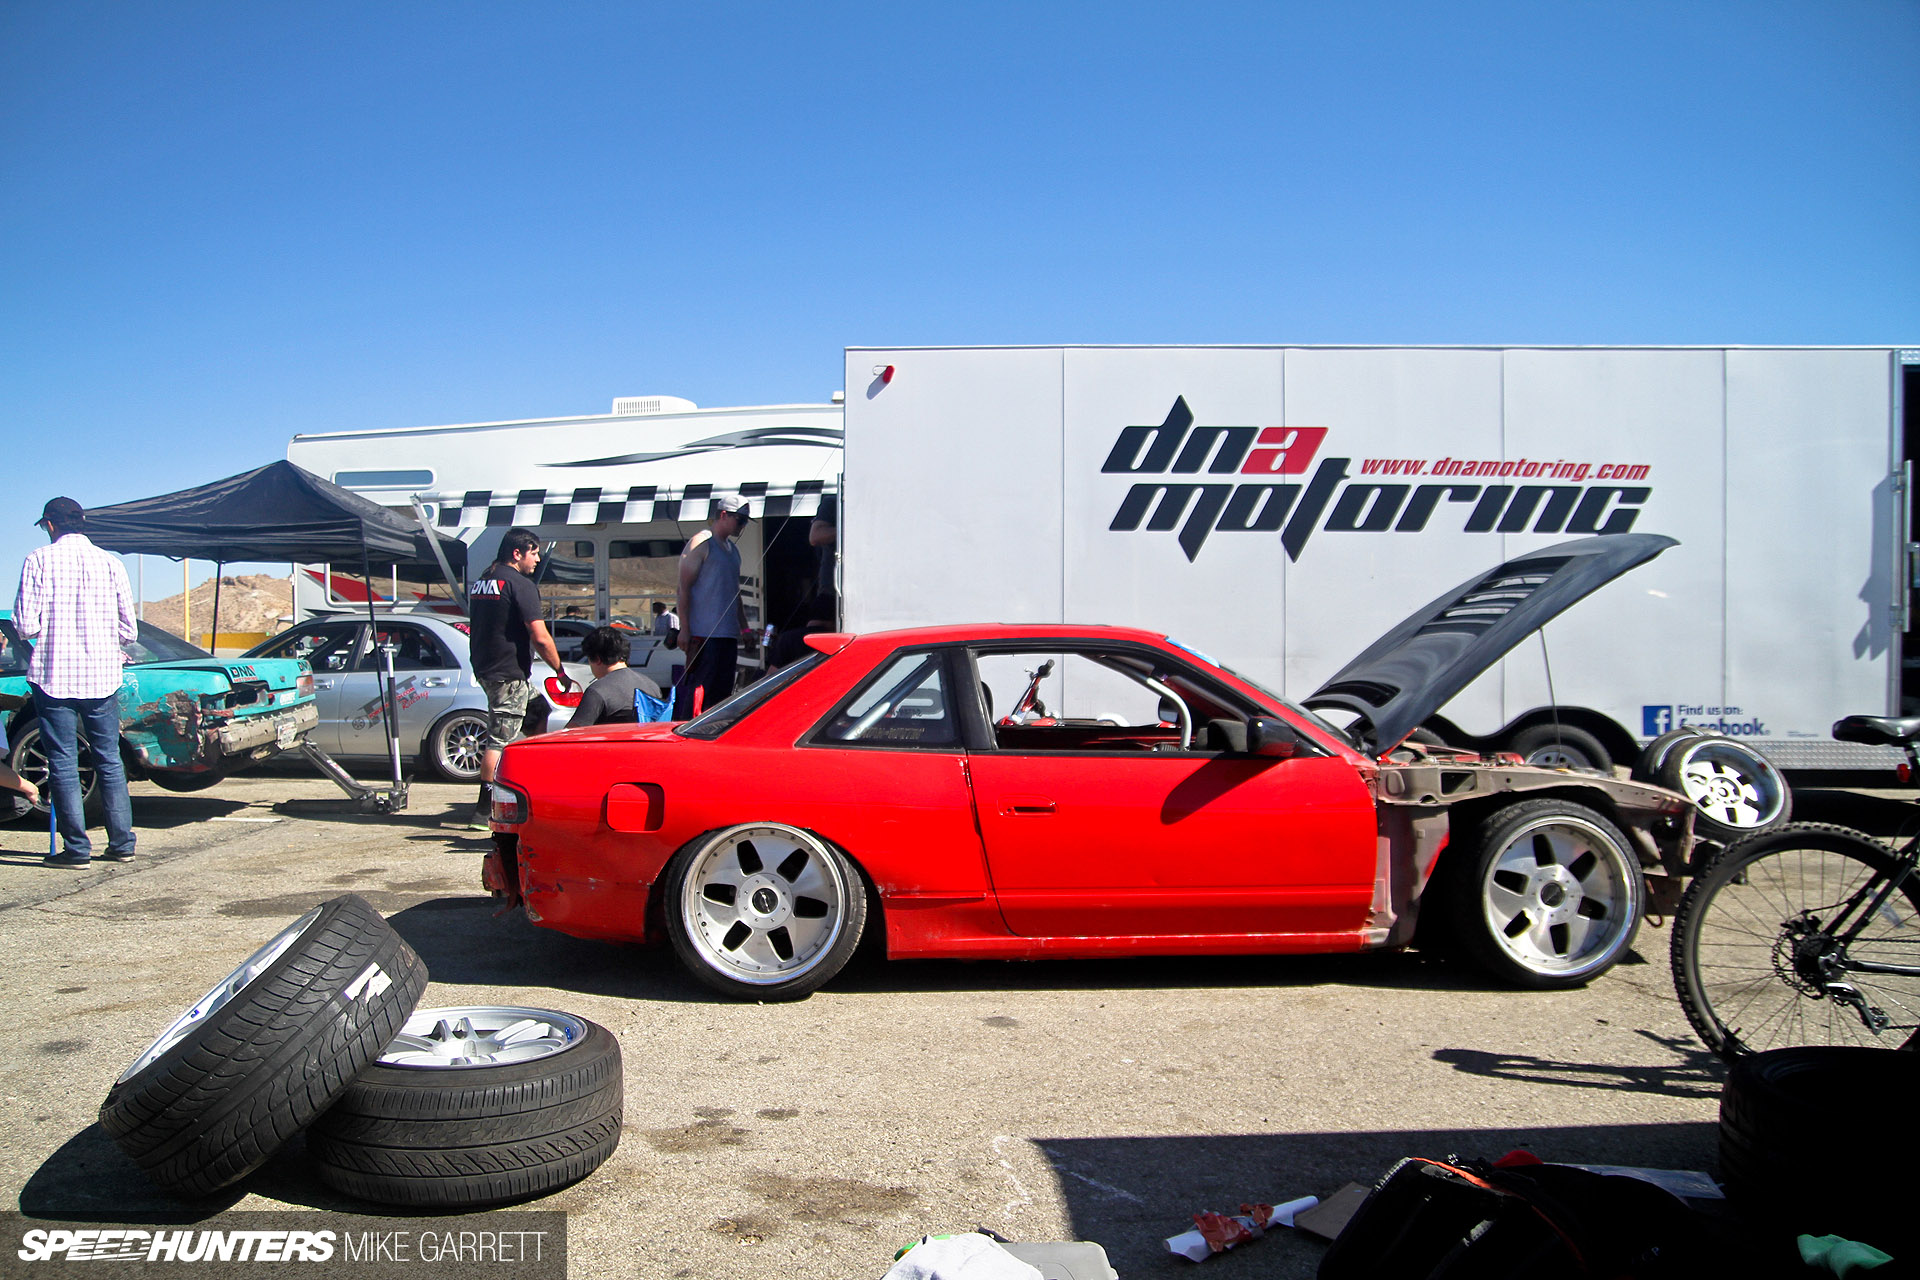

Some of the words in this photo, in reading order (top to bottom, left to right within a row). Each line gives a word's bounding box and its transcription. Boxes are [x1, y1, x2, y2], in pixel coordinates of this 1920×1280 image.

[1101, 394, 1329, 474] dna
[1360, 457, 1652, 482] www.dnamotoring.com
[471, 579, 505, 595] DNA
[230, 665, 257, 678] DNA
[1678, 705, 1703, 715] Find
[1707, 706, 1720, 715] us
